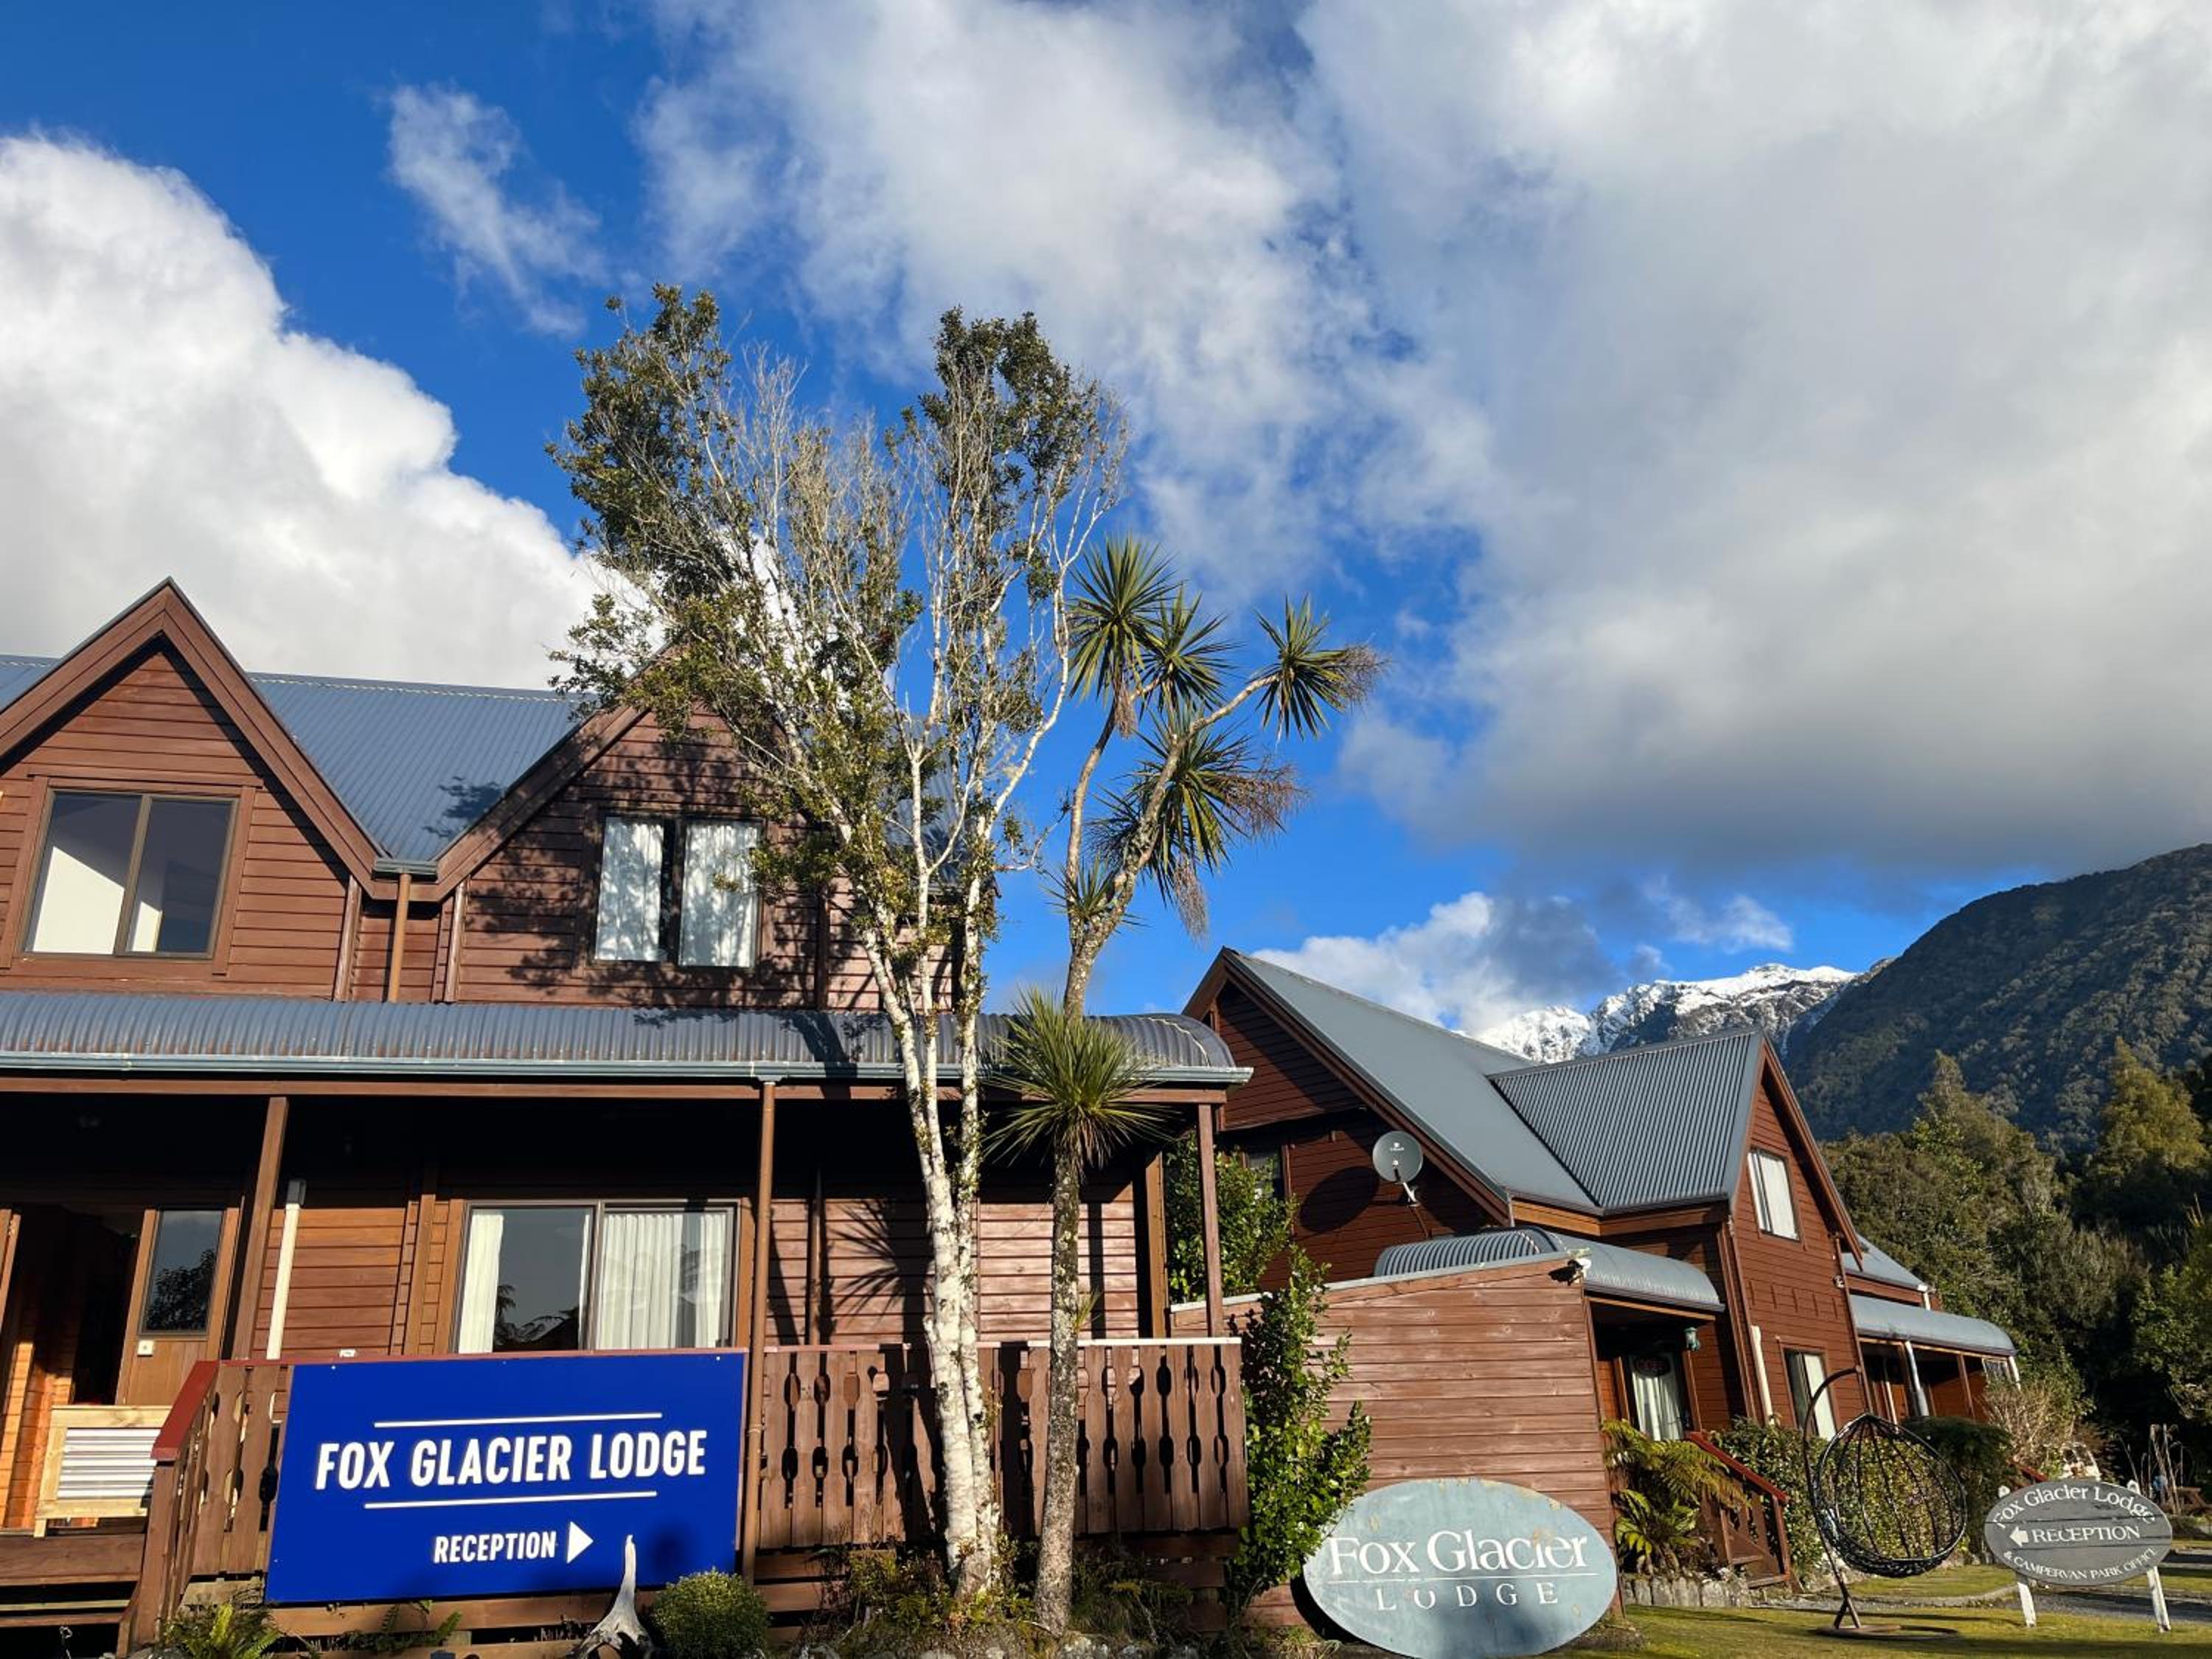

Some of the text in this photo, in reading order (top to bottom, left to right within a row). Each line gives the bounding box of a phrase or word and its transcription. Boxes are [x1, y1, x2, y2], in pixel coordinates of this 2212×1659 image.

[316, 1430, 708, 1490] FOX GLACIER LODGE
[2024, 1484, 2088, 1506] Glacier
[2094, 1486, 2155, 1524] Lodge
[434, 1531, 557, 1563] RECEPTION
[1327, 1528, 1587, 1576] Fox Glacier
[2031, 1526, 2140, 1543] RECEPTION
[2090, 1566, 2124, 1579] PARK
